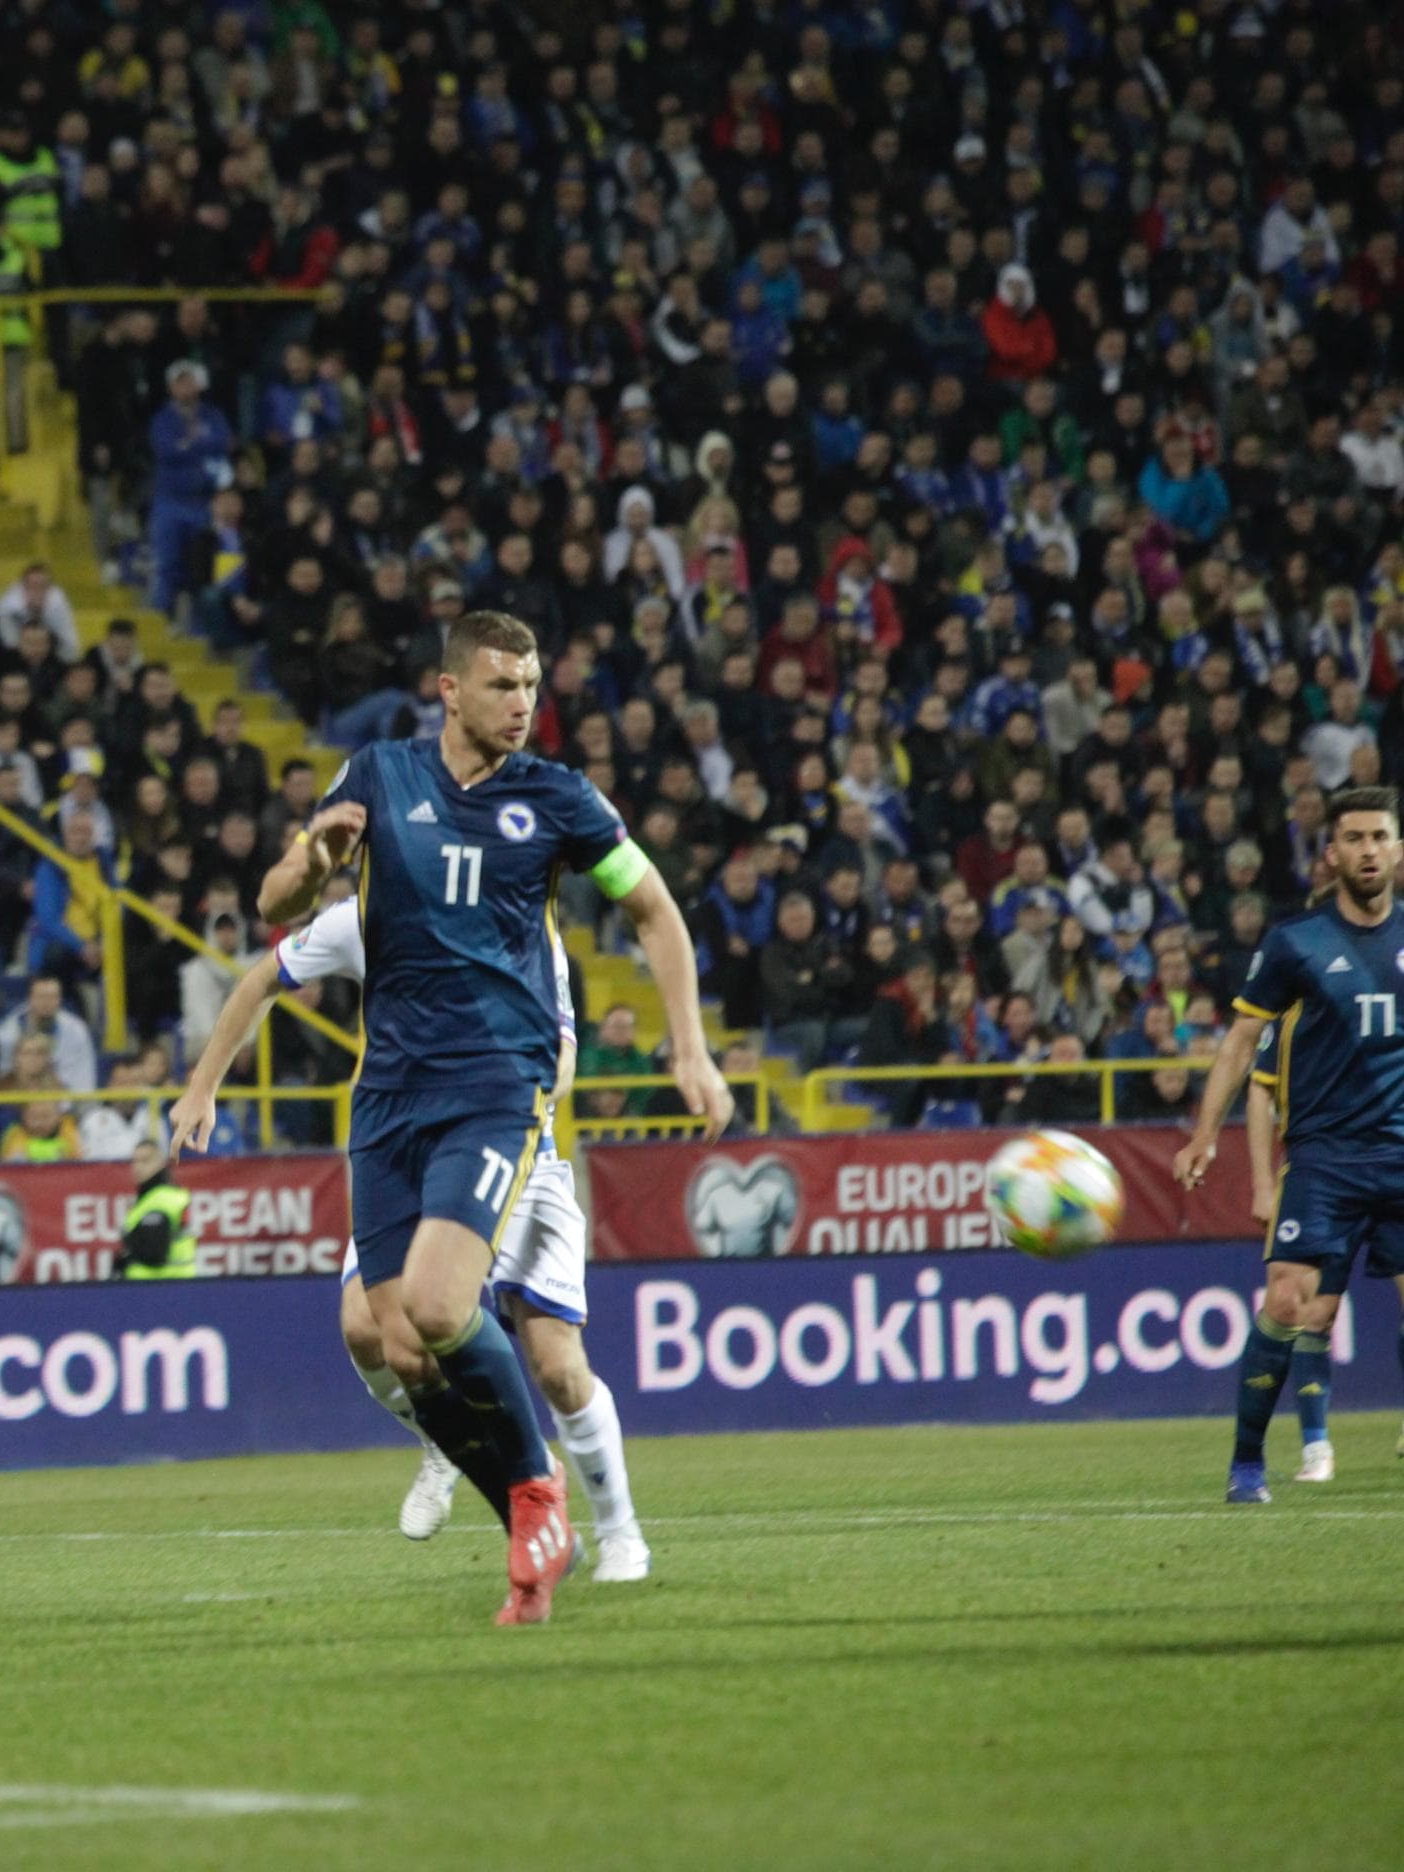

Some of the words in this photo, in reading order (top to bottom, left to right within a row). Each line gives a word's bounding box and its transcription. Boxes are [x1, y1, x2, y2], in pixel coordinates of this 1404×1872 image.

[440, 844, 483, 906] 11
[473, 1146, 514, 1213] 11
[836, 1160, 997, 1213] EUROP
[65, 1186, 314, 1242] EUPEAN
